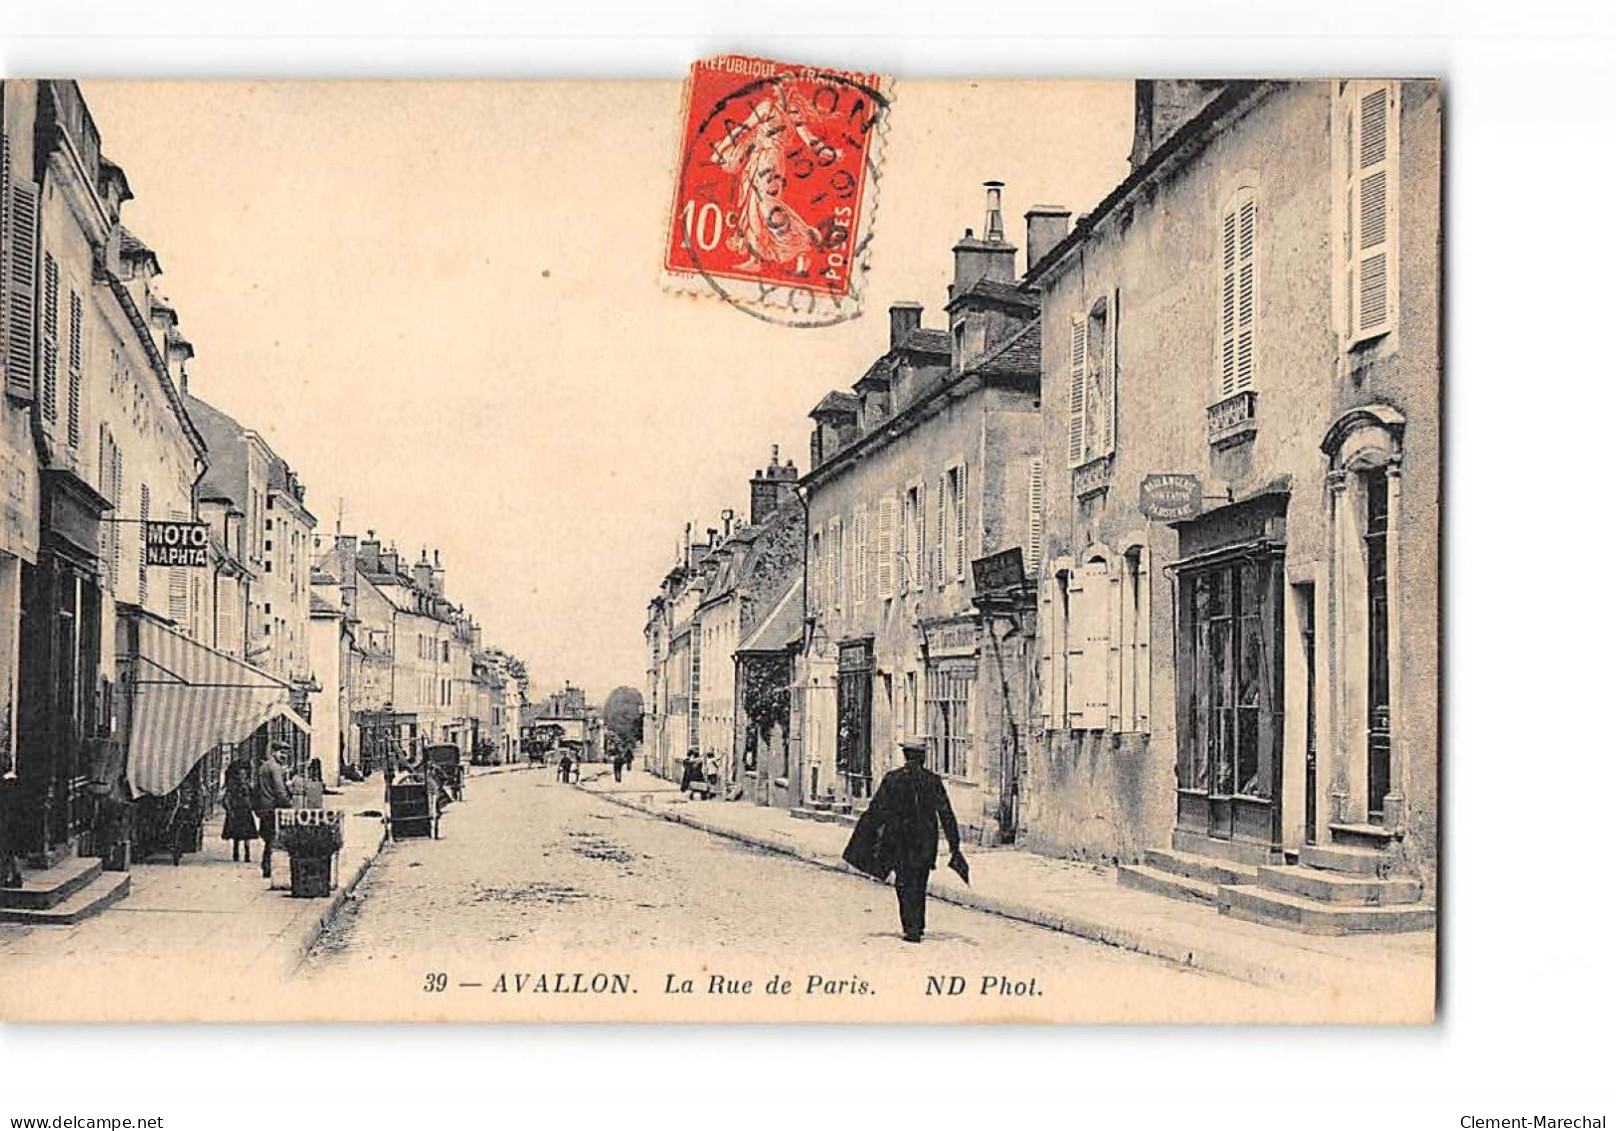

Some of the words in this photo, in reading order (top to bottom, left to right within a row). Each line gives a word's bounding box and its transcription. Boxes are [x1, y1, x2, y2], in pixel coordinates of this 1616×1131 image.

[826, 206, 852, 280] POES
[148, 524, 207, 546] MOTO
[148, 547, 206, 565] NAPHTA
[424, 973, 447, 992] 39
[493, 974, 637, 993] AVALLON.
[665, 974, 692, 993] La
[708, 975, 752, 993] Rue
[766, 975, 791, 994] de
[807, 976, 875, 995] Paris.
[926, 976, 965, 995] ND
[981, 976, 1042, 996] Phot.
